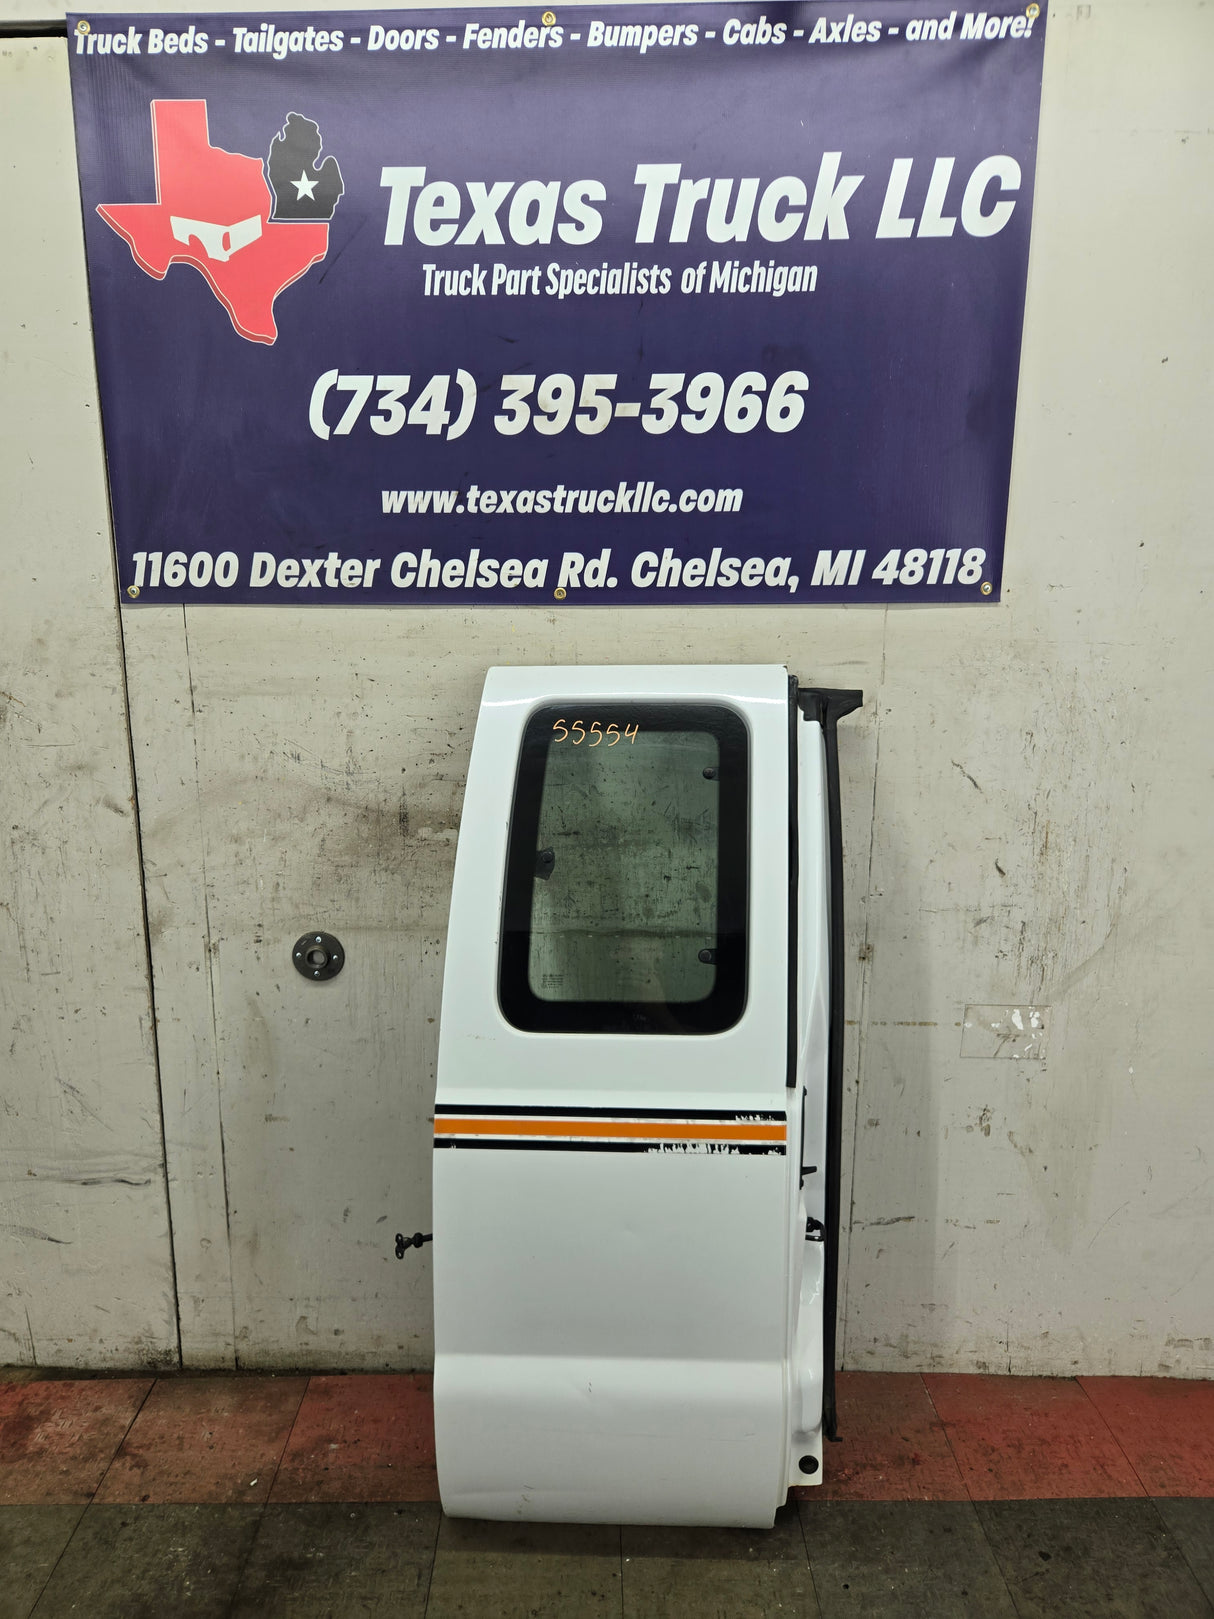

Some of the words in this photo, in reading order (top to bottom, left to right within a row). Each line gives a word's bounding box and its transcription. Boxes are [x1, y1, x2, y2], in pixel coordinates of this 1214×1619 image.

[74, 26, 143, 55] Truck
[147, 26, 209, 54] Beds
[233, 23, 345, 60] Tailgates
[367, 24, 440, 51] Doors
[462, 19, 565, 49] Fenders
[586, 20, 699, 54] Bumpers
[722, 15, 788, 46] Cabs
[808, 13, 883, 44] Axles
[905, 10, 958, 41] and
[959, 12, 1036, 40] More!
[379, 166, 607, 247] Texas
[633, 151, 866, 244] Truck
[875, 154, 1023, 239] LLC
[422, 263, 488, 296] Truck
[491, 264, 542, 296] Part
[545, 262, 673, 300] Specialists
[680, 261, 708, 294] of
[708, 259, 818, 297] Michigan
[308, 368, 477, 441] (734)
[494, 370, 809, 437] 395-3966
[381, 481, 744, 514] www.texastruckllc.com
[132, 551, 239, 588] 11600
[249, 552, 382, 588] Dexter
[390, 548, 549, 588] Chelsea
[557, 548, 618, 588] Rd.
[631, 547, 799, 593] Chelsea,
[810, 549, 867, 586] MI
[871, 547, 987, 586] 48118
[552, 718, 640, 747] 55554
